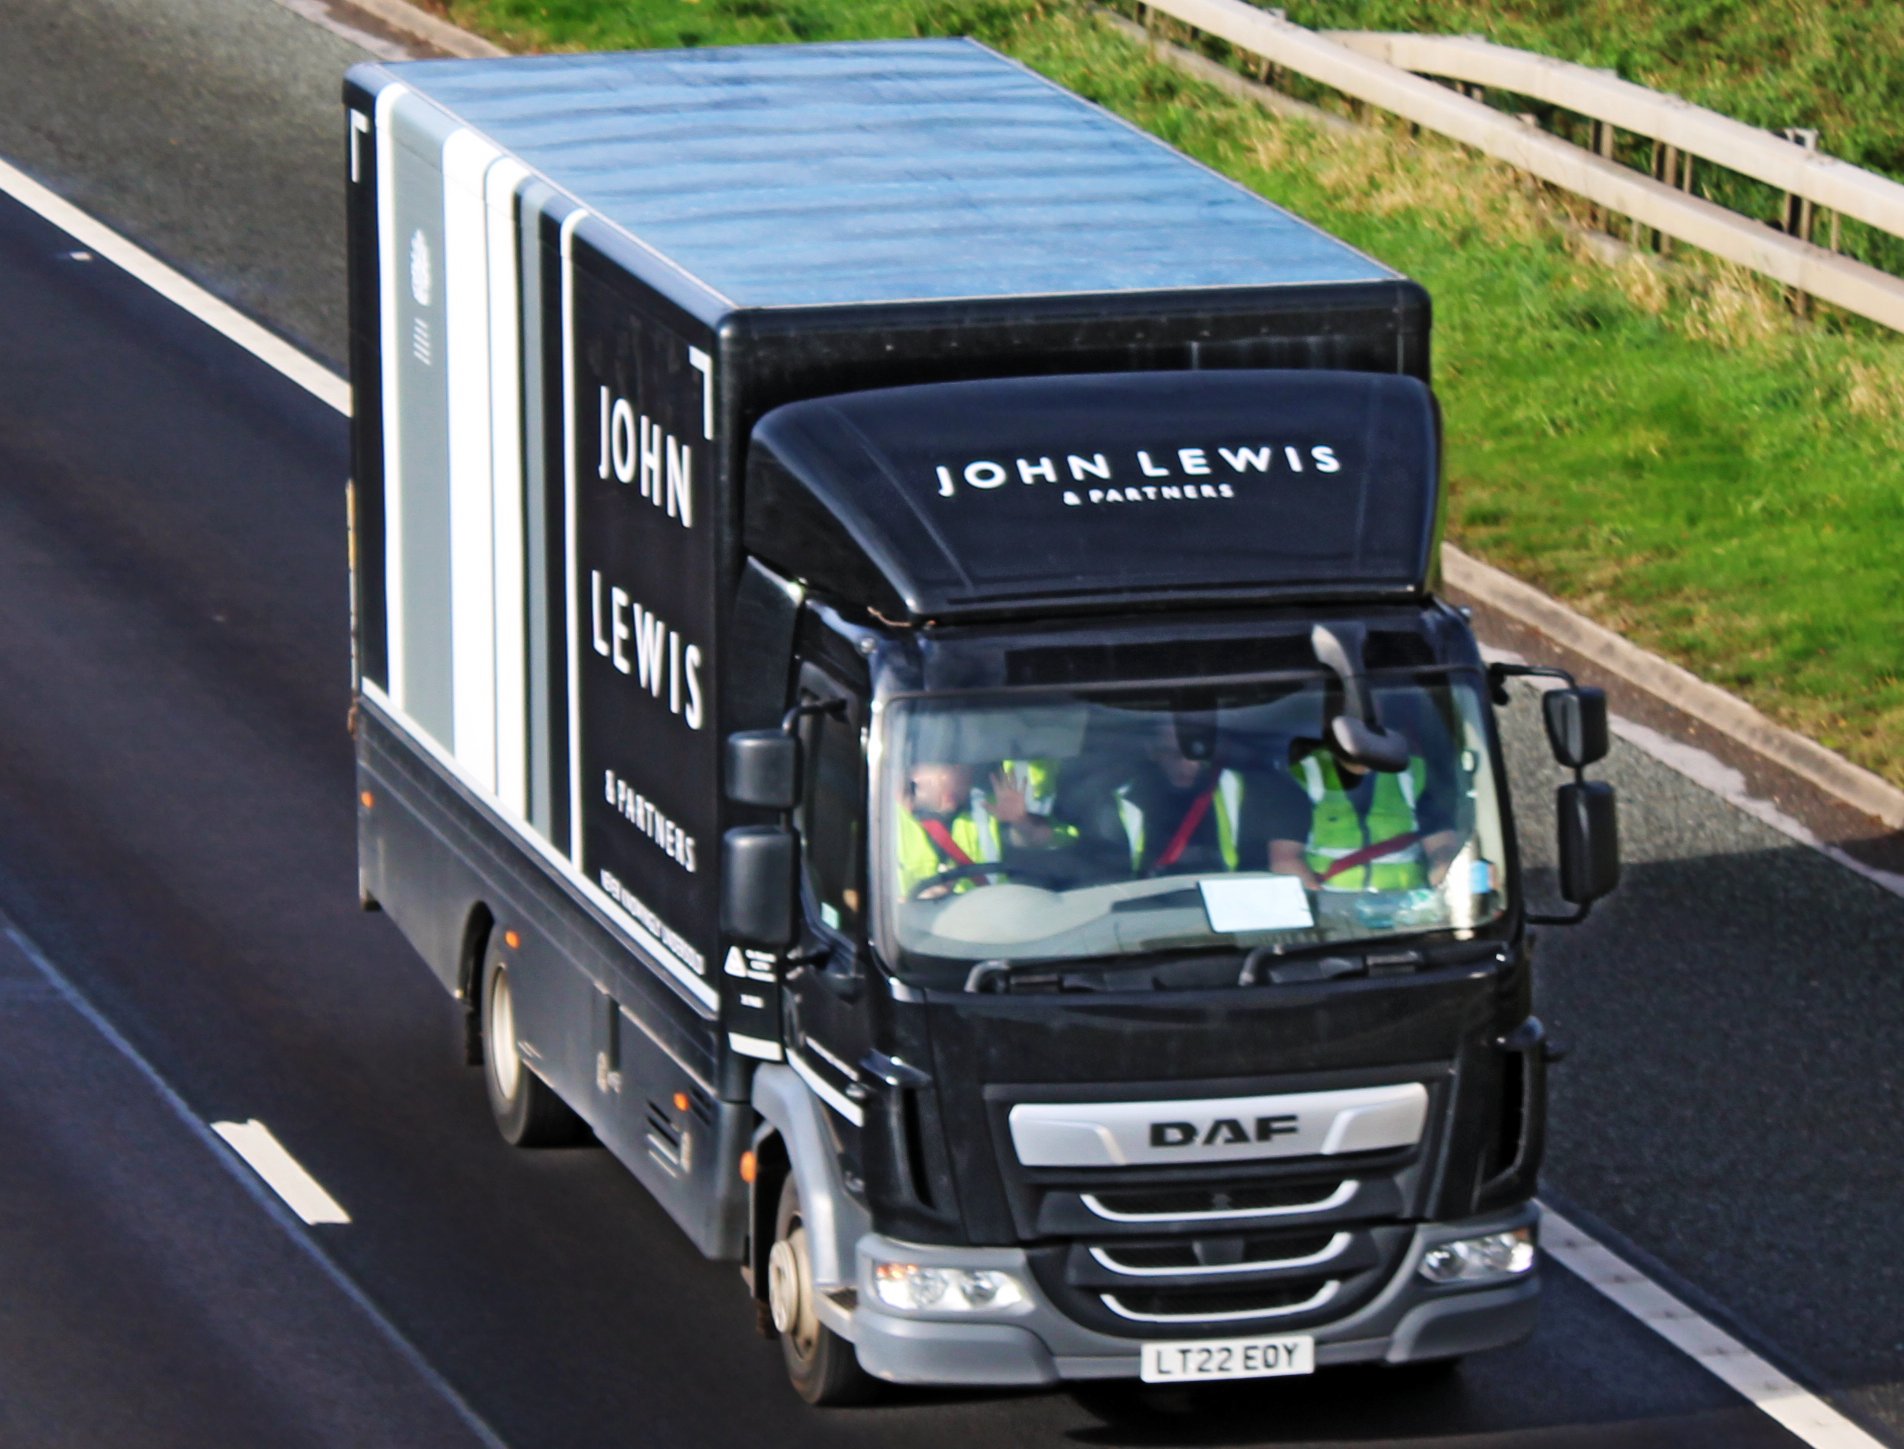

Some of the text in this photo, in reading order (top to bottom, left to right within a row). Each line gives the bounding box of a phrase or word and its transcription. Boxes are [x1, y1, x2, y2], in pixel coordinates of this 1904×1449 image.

[598, 384, 692, 528] JOHN
[936, 446, 1341, 497] JOHN LEWIS
[1089, 483, 1235, 504] PARTNERS
[592, 570, 702, 731] LEWIS
[617, 779, 696, 873] PARTNERS
[1150, 1115, 1299, 1148] DAF
[1157, 1342, 1300, 1375] LT22 EOY
